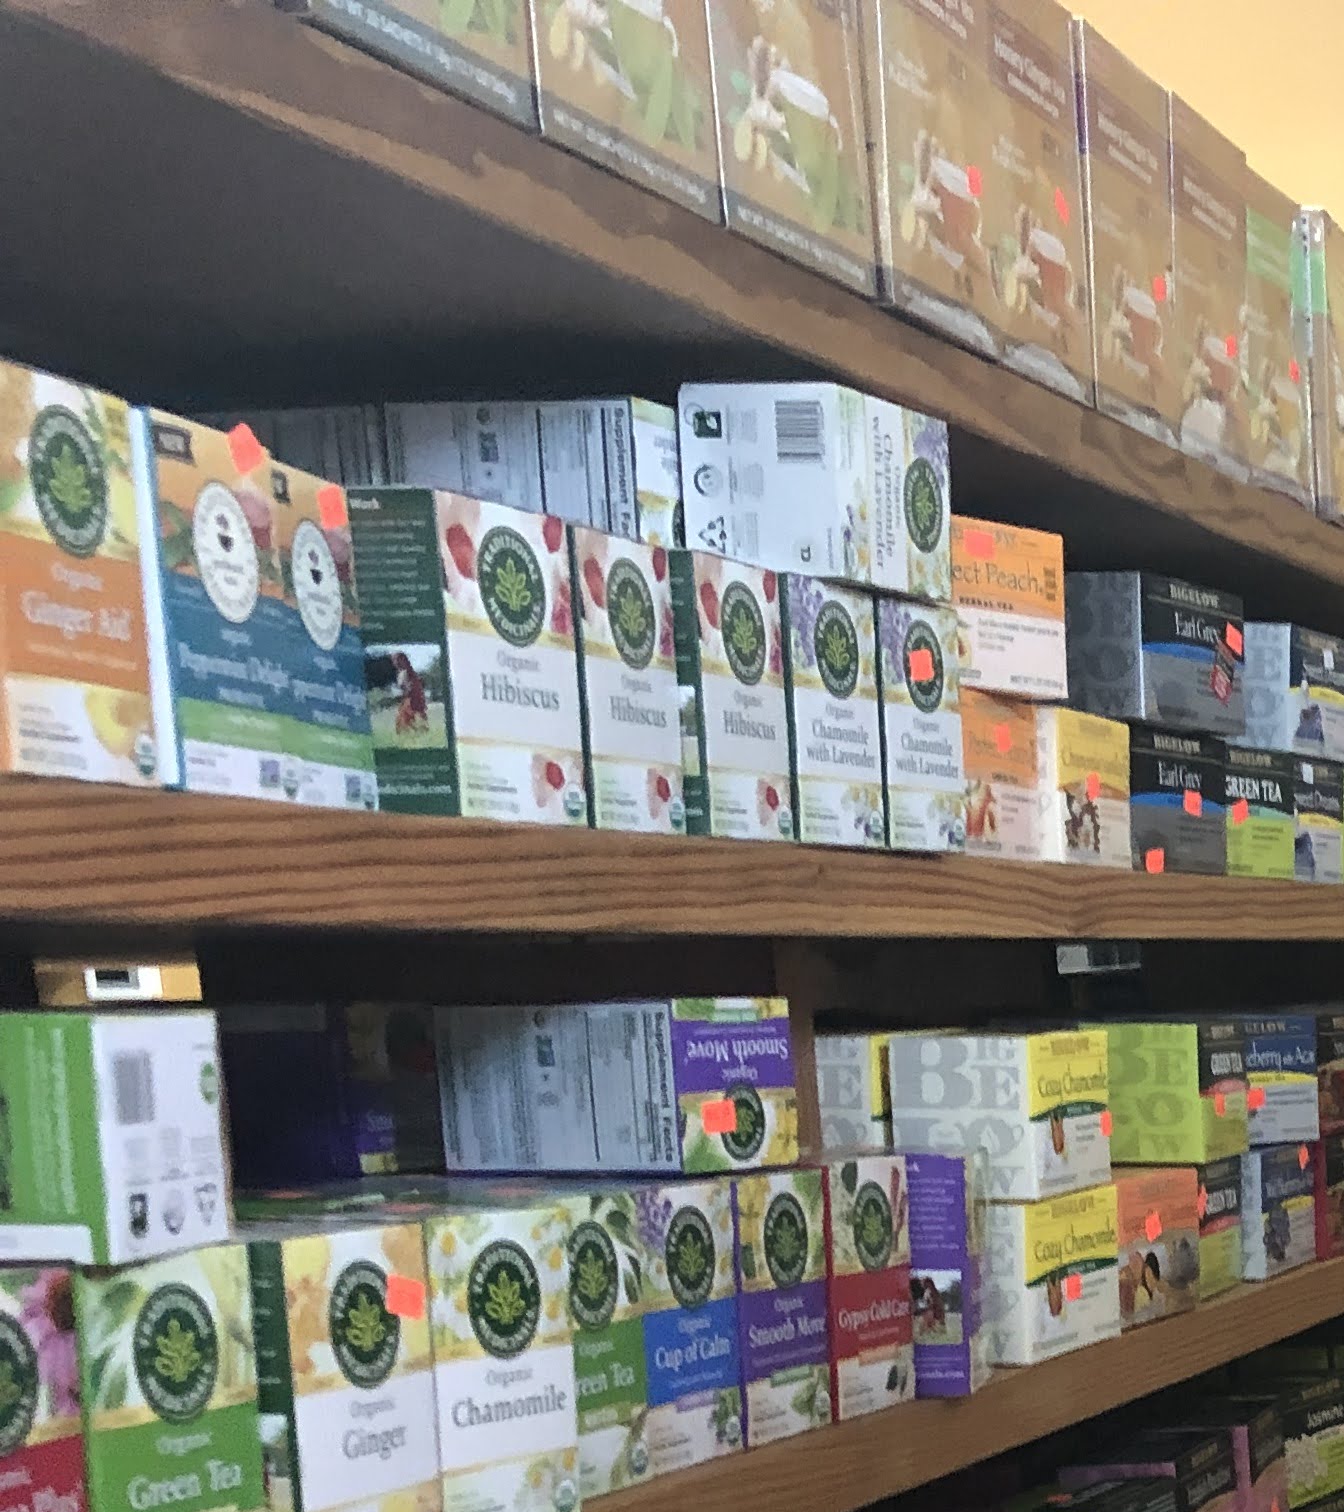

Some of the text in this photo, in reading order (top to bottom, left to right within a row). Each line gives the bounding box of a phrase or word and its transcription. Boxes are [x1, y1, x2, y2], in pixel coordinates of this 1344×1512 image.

[1174, 611, 1196, 638] Earl
[480, 672, 560, 711] Hibiscus
[608, 695, 668, 729] Hibiscus
[723, 710, 776, 741] Hibiscus
[811, 719, 869, 745] Chamomile
[900, 732, 953, 757] Chamomile
[832, 746, 876, 769] Lavender
[918, 758, 959, 780] Lavender
[1158, 760, 1179, 786] Earl
[1262, 779, 1283, 803] TEA
[686, 1038, 789, 1064] Smooth Move
[749, 1315, 827, 1348] Smooth Move
[838, 1305, 867, 1332] Gypsy
[654, 1333, 731, 1372] Cup of Calm
[577, 1361, 634, 1397] reen Tea
[450, 1386, 568, 1431] Chamomile
[1306, 1403, 1344, 1429] Jasmine
[342, 1421, 409, 1463] Ginger
[127, 1461, 242, 1510] Green Tea
